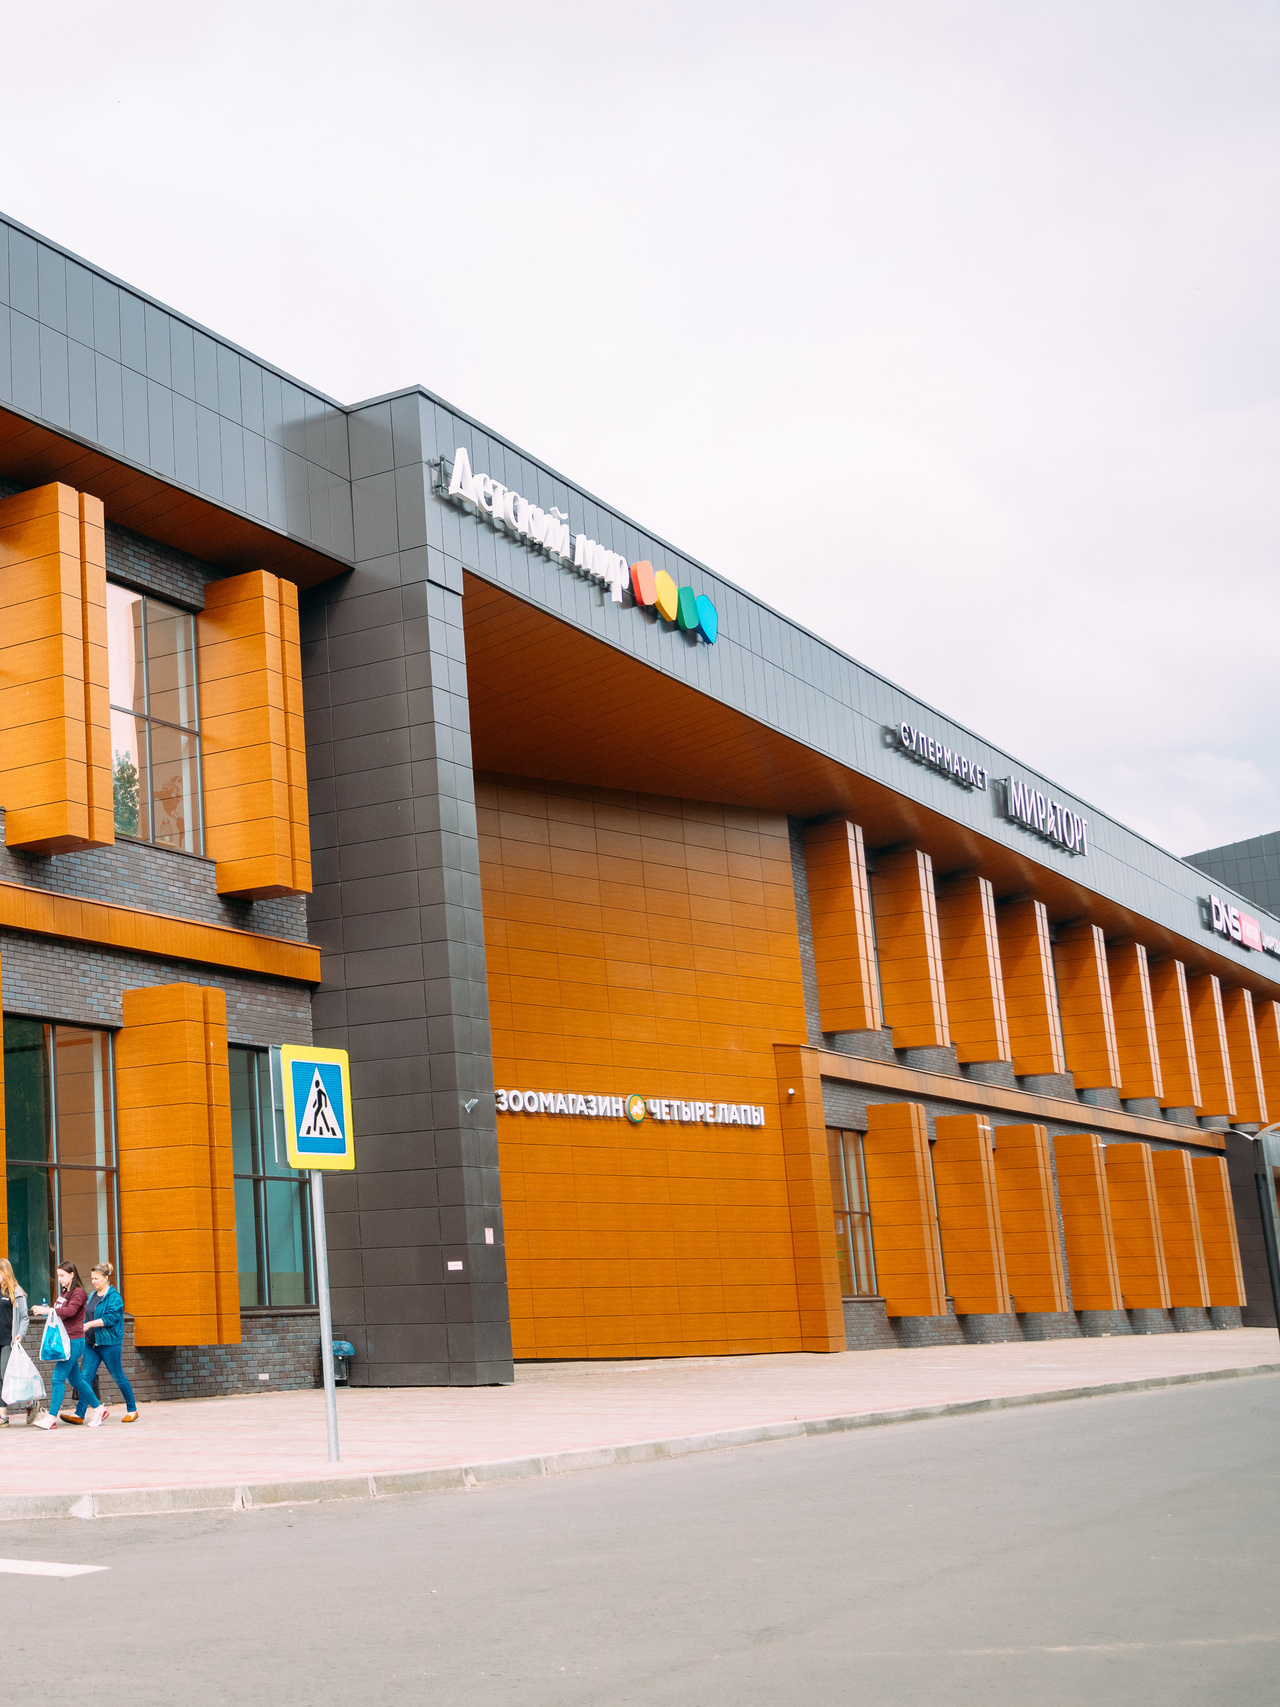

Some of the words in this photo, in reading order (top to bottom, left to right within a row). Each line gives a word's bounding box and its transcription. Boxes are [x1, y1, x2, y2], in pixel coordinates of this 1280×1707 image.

[898, 721, 989, 792] СУПЕРМАРКЕТ
[1006, 775, 1088, 857] МИРАТОРГ
[1209, 894, 1242, 942] DNS
[495, 1089, 624, 1118] ЗООМАГАЗИН
